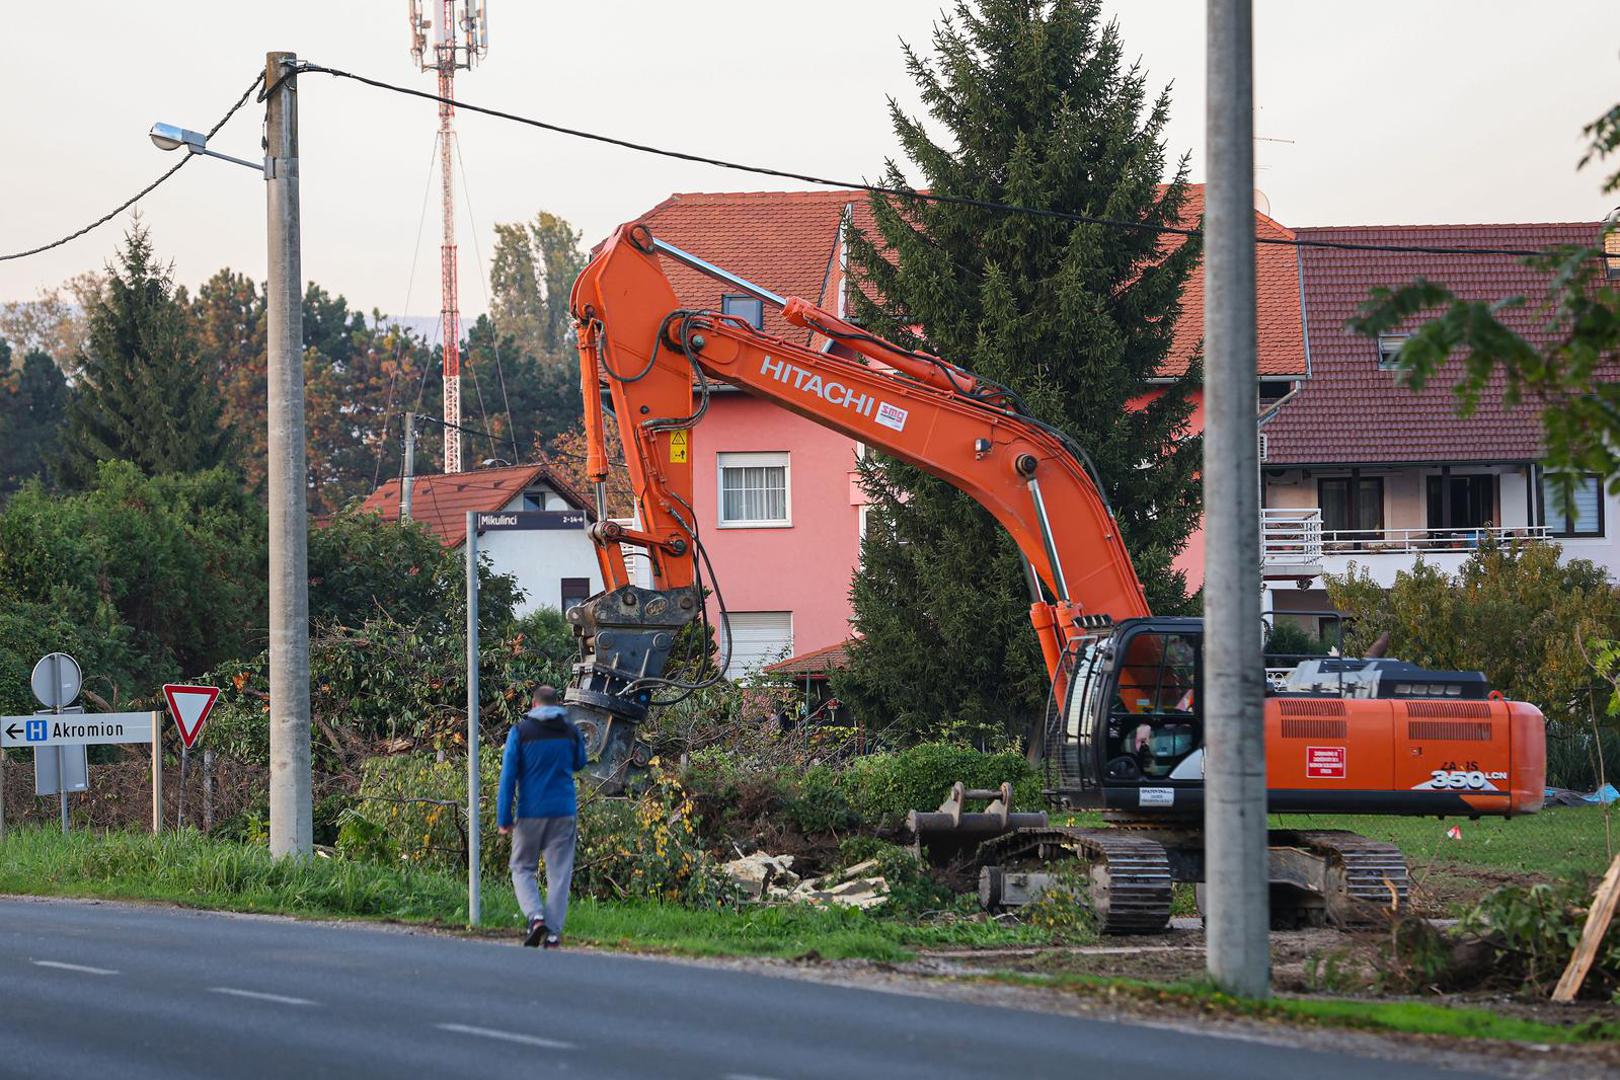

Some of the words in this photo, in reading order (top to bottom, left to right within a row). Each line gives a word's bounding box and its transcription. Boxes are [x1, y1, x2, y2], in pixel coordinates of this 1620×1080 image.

[760, 355, 875, 417] HITACHI
[481, 515, 517, 525] Mikulinci
[30, 722, 42, 740] H
[53, 722, 124, 738] Akromion
[1431, 770, 1485, 789] 350
[1485, 772, 1507, 780] LCN
